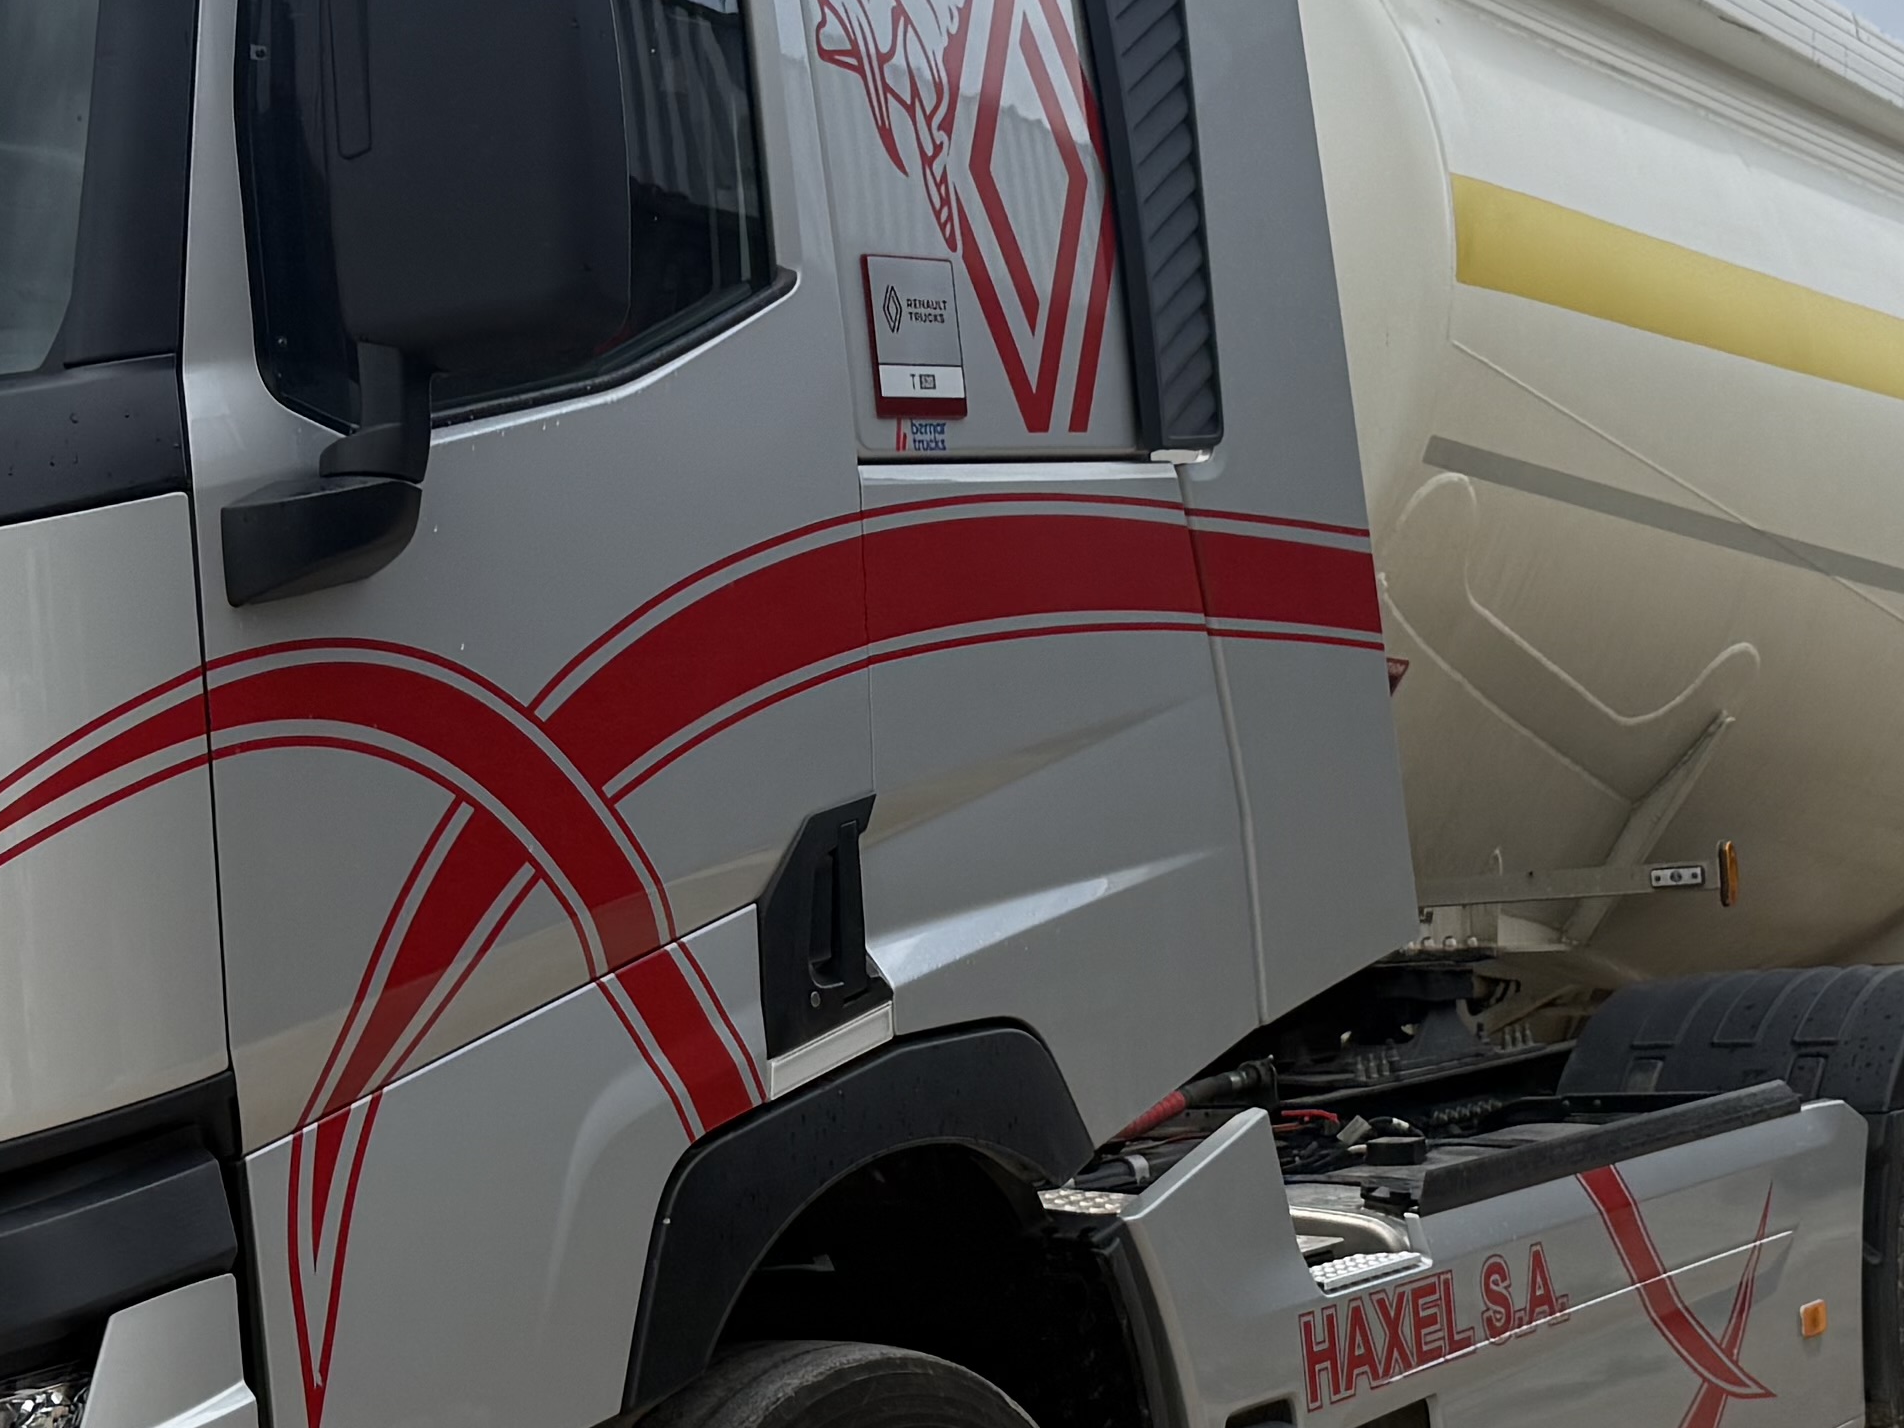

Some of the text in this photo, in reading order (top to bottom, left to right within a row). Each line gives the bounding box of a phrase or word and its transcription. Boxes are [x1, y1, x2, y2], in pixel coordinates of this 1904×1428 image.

[906, 298, 947, 311] RENAULT
[908, 311, 945, 324] TRUCKS
[912, 435, 947, 451] trucks
[1298, 1241, 1570, 1413] HAXEL S.A.
